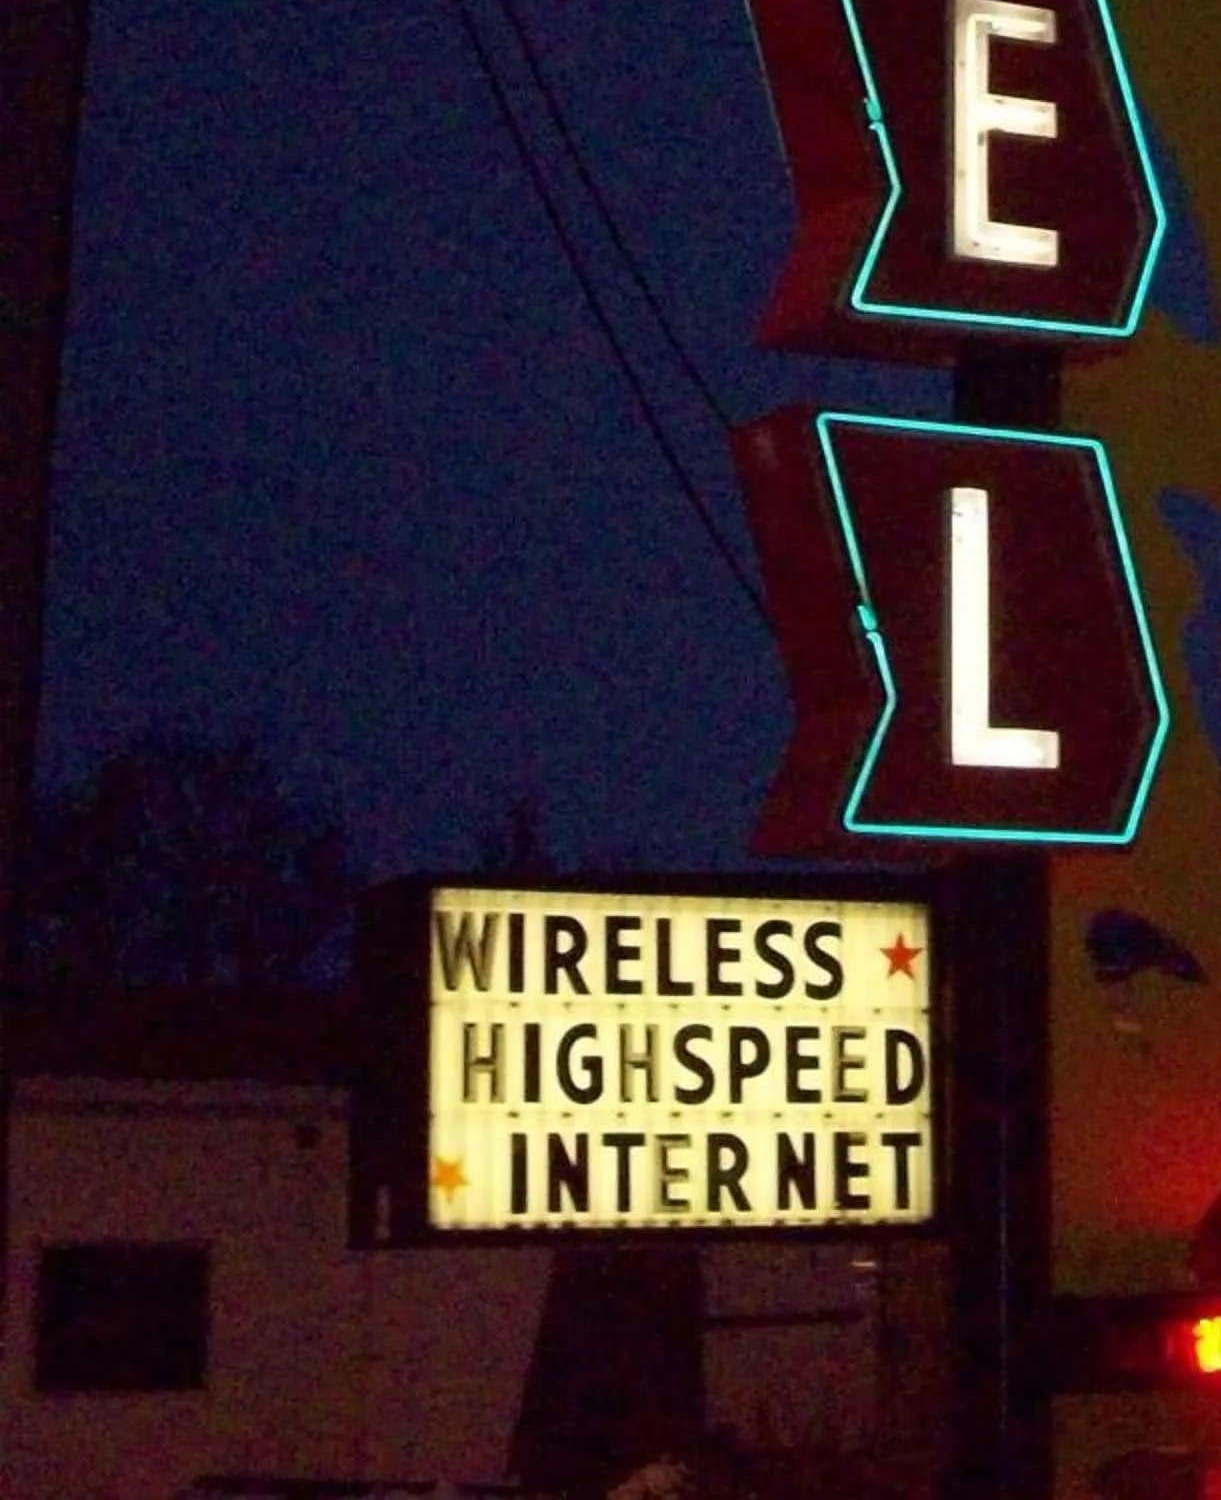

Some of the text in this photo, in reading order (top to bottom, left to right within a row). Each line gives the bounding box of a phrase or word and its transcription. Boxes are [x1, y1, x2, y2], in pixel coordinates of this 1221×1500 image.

[435, 911, 845, 1000] WIRELESS
[462, 1023, 924, 1105] HIGHSPEED
[510, 1132, 923, 1214] INTERNET
